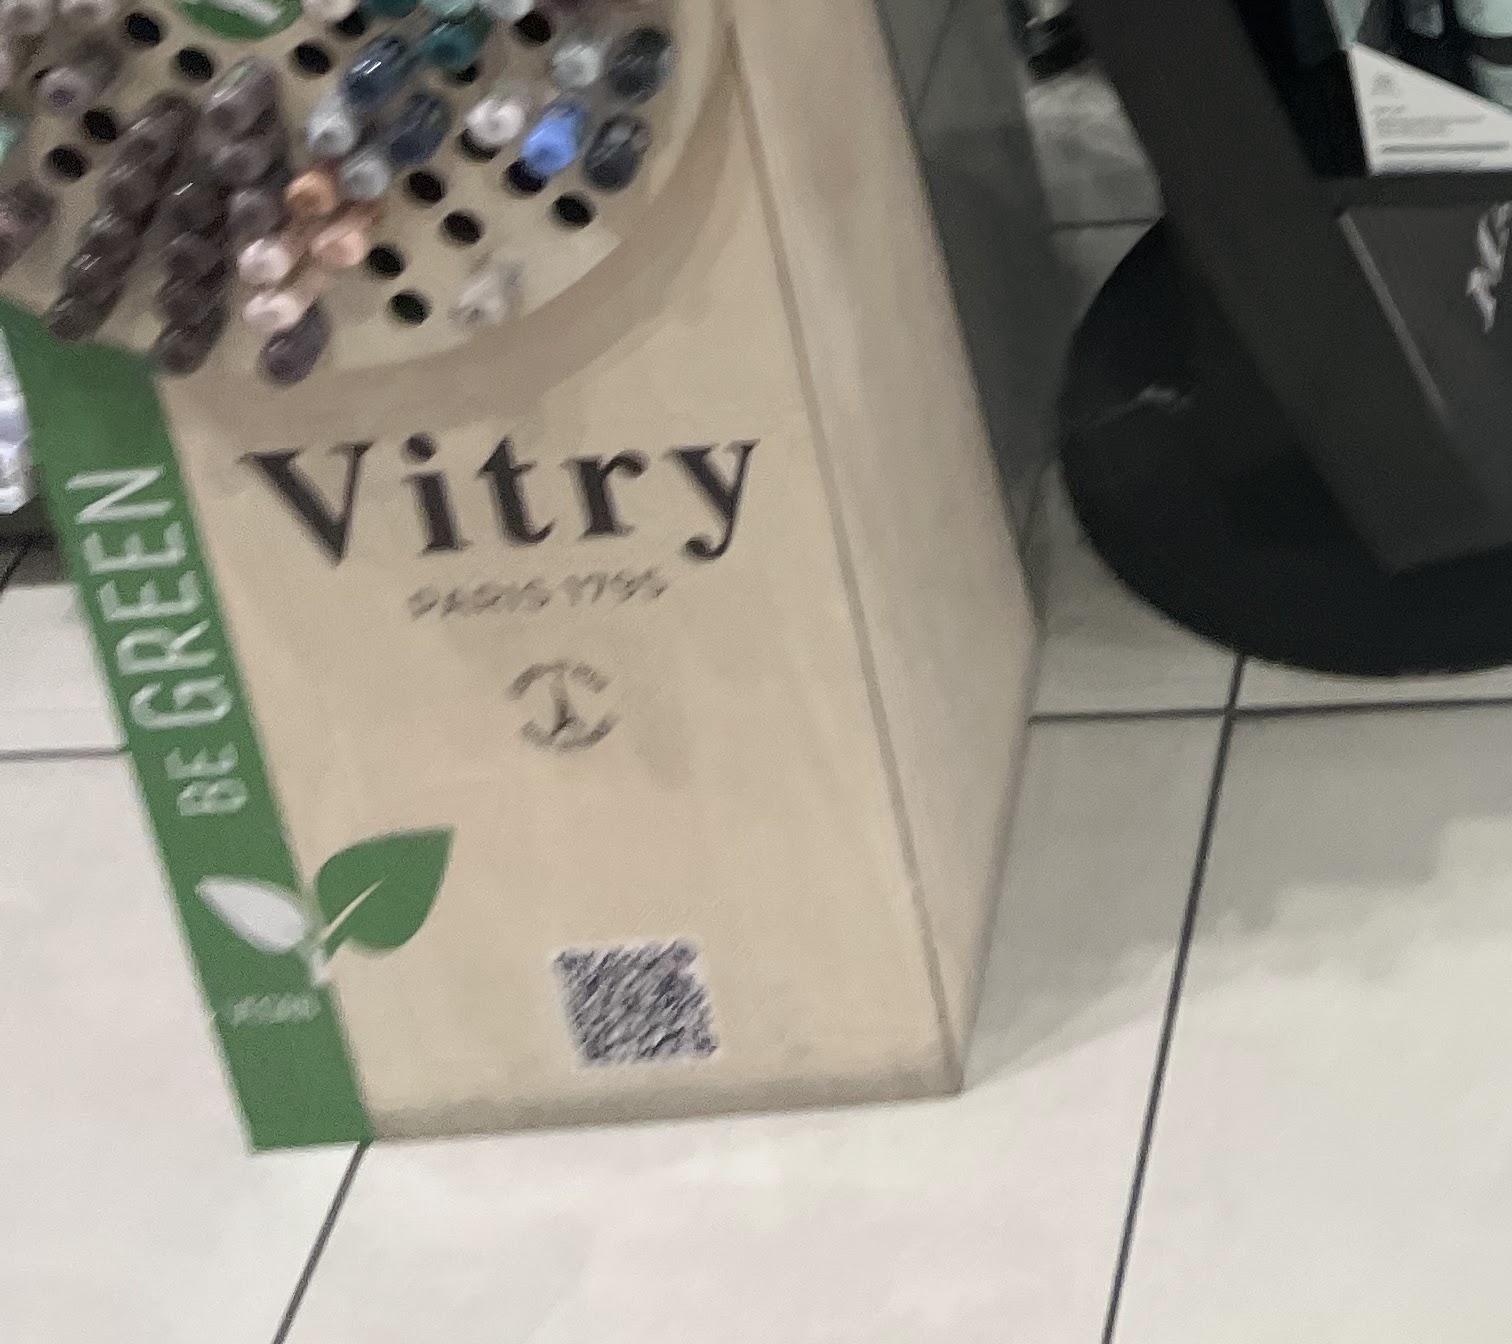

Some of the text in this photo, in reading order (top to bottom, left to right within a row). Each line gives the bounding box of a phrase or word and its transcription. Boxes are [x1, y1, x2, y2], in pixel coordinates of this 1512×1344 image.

[237, 431, 759, 568] Vitry
[64, 463, 249, 817] BE GREEN
